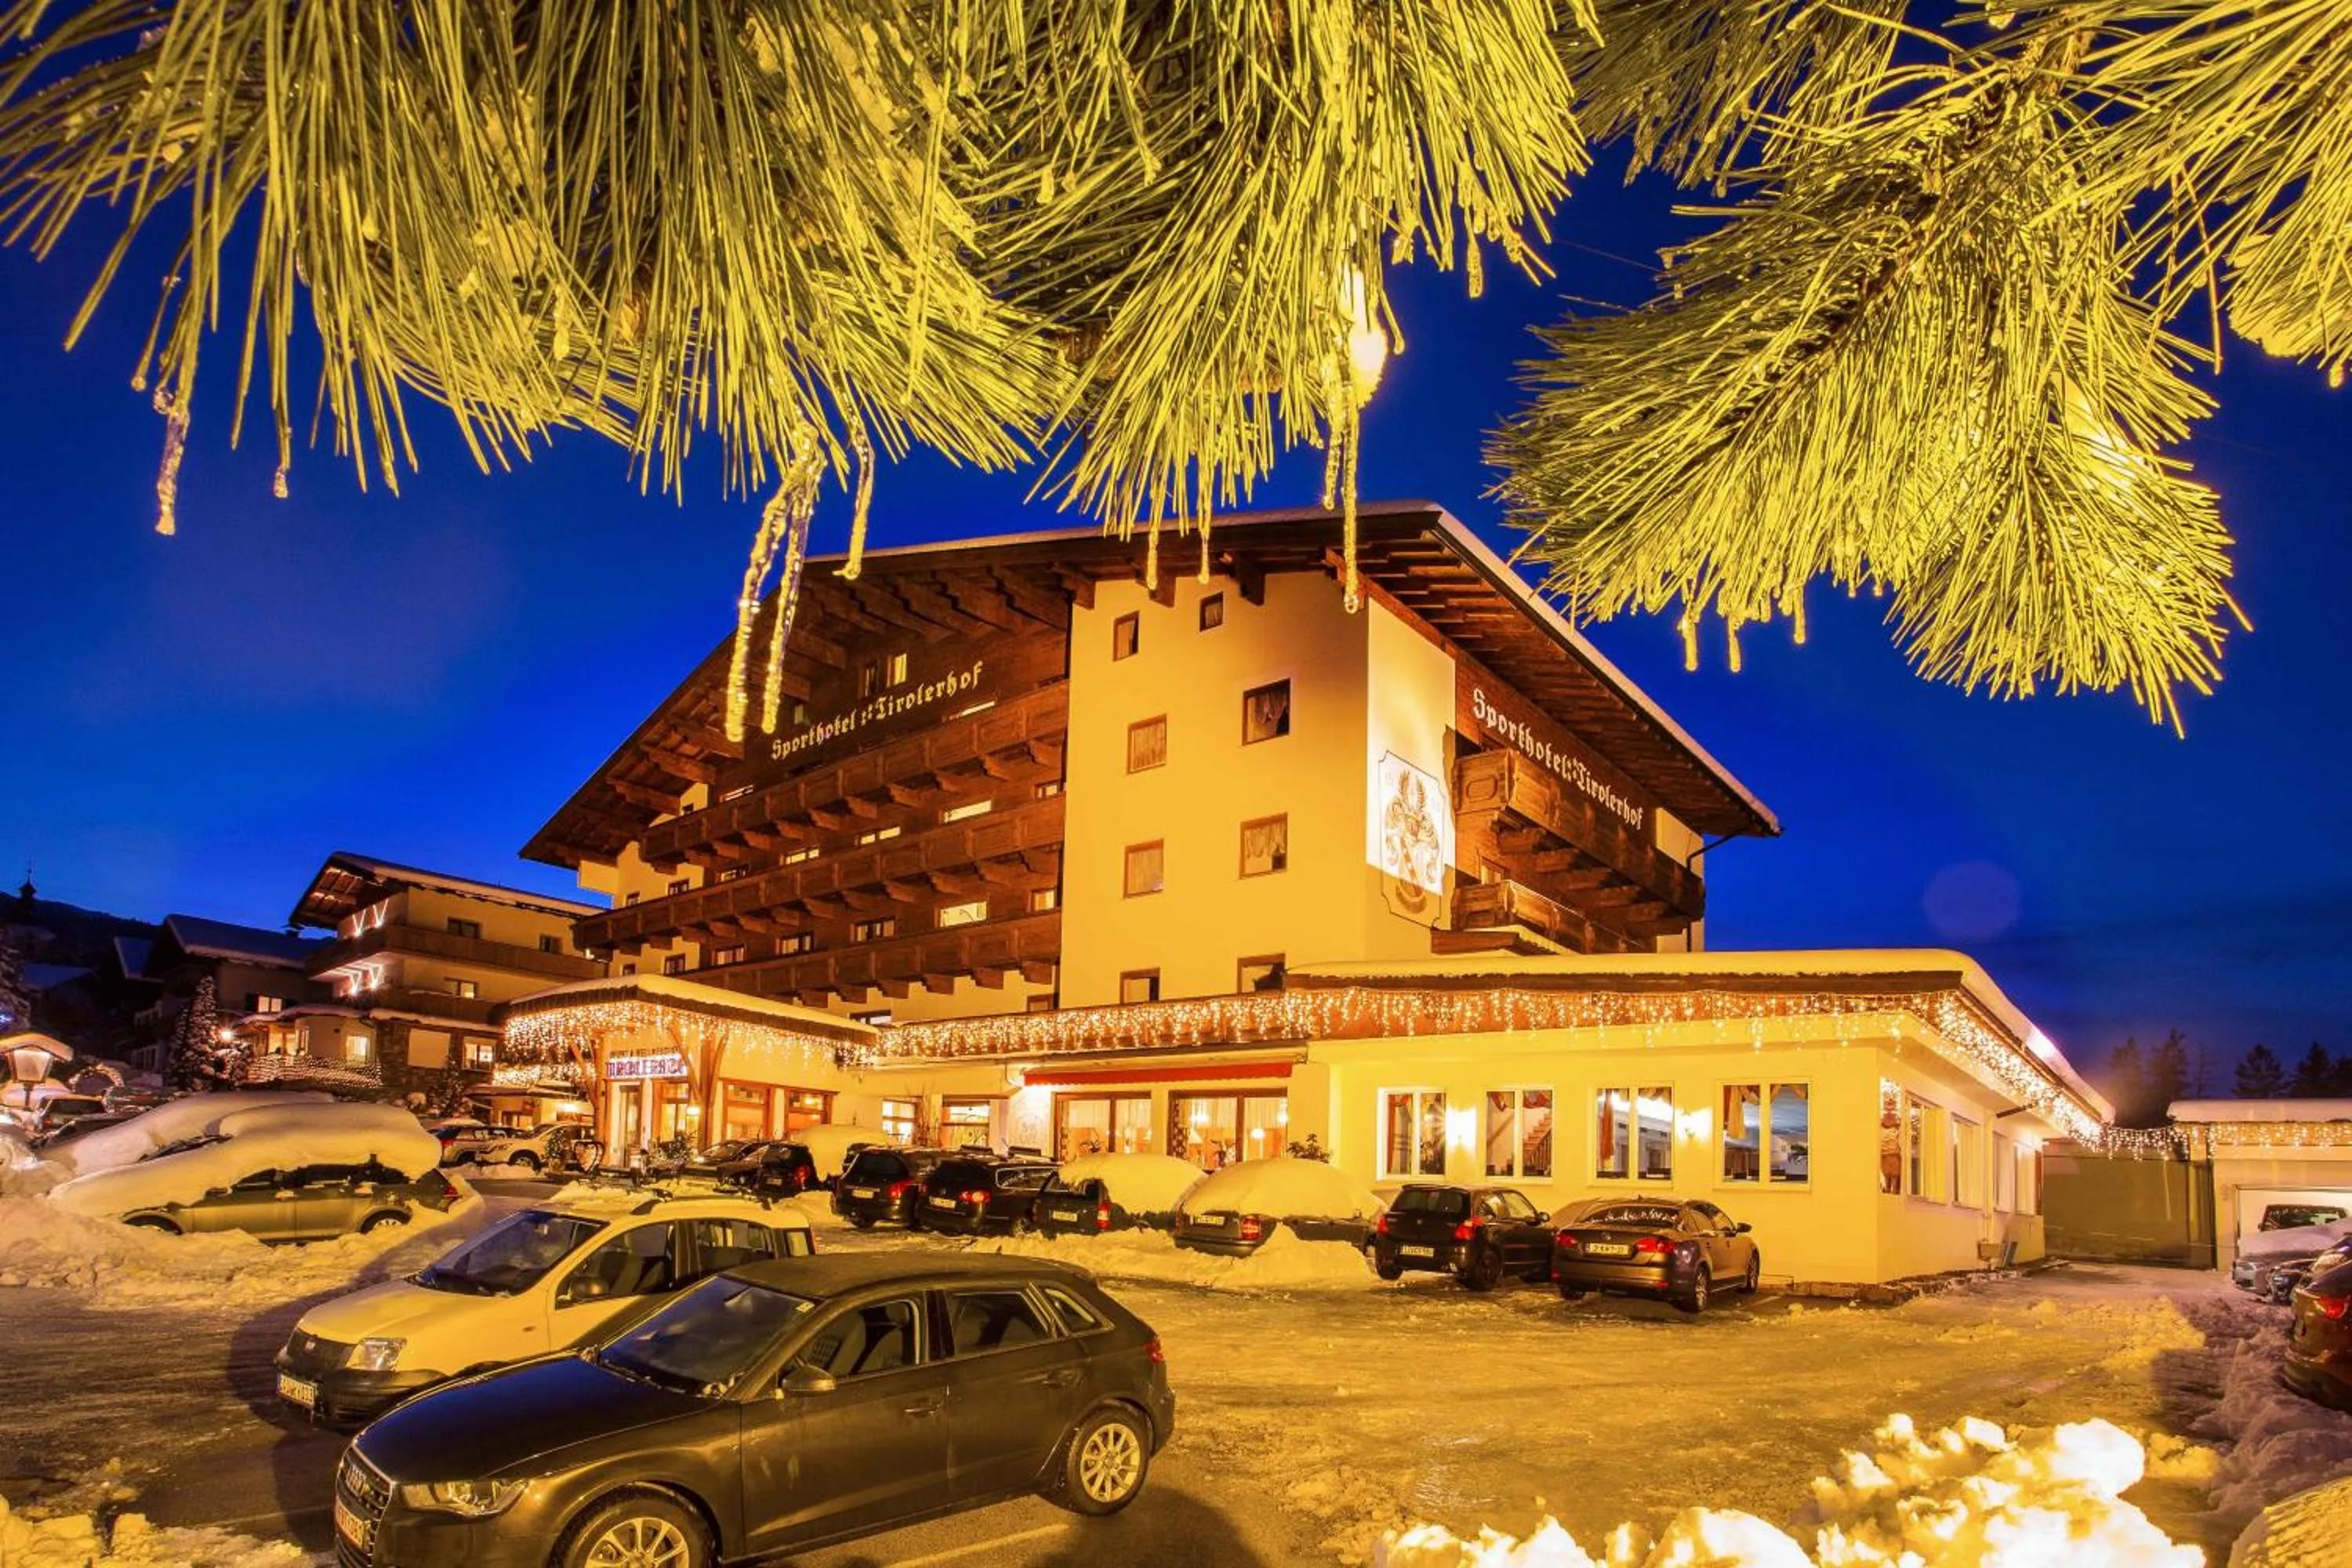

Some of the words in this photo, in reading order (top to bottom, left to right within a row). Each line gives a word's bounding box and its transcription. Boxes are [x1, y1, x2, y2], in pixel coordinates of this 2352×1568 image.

[771, 709, 856, 760] Sporthotel
[876, 660, 983, 720] Tirolerhof
[1472, 686, 1567, 779] Sporthotel
[1576, 761, 1644, 830] Tirolerhof
